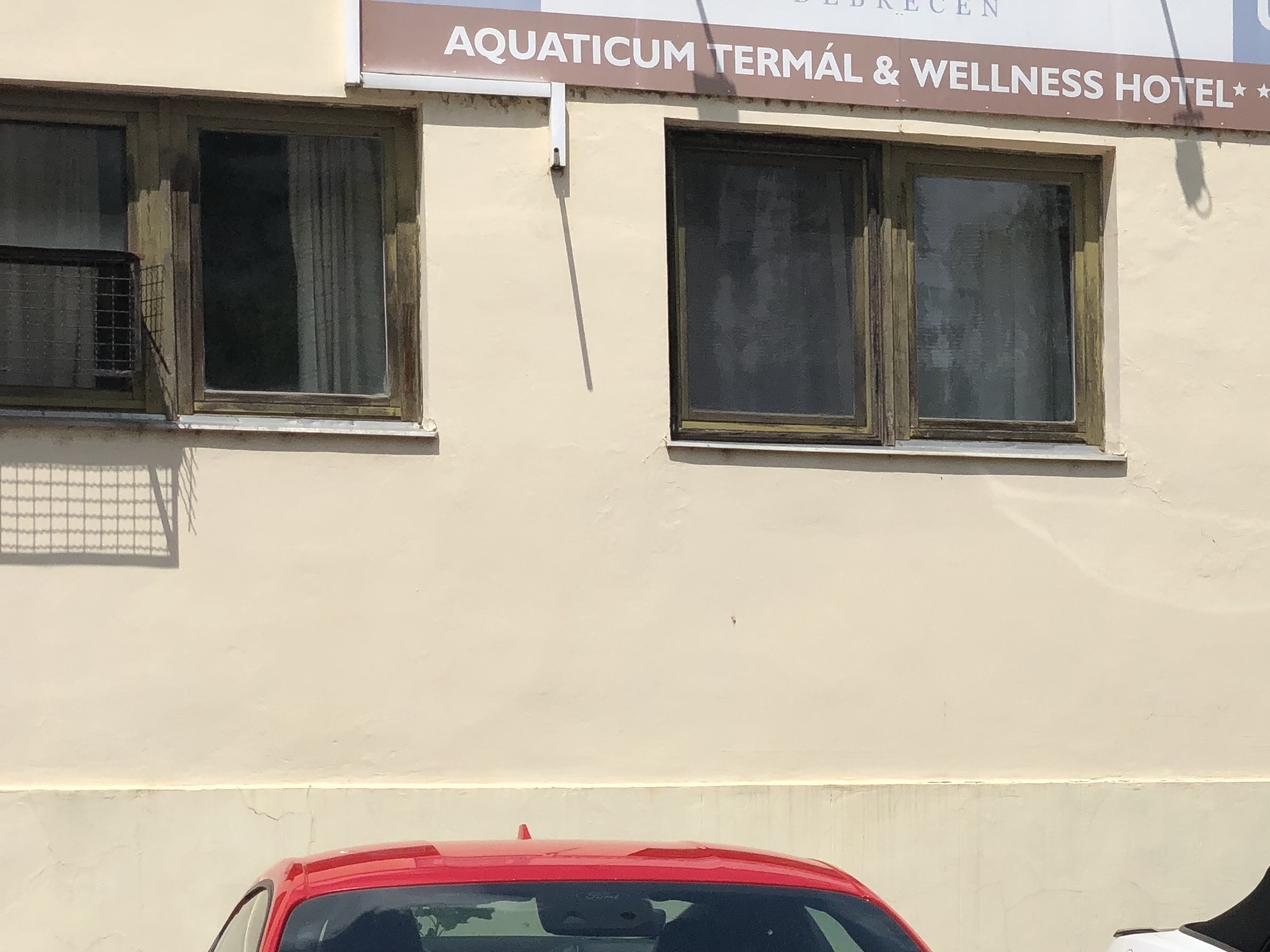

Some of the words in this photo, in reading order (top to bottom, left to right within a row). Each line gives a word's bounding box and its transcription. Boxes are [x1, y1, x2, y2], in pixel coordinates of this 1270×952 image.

[444, 25, 695, 70] AQUATICUM
[707, 42, 863, 83] TERMÁL
[872, 55, 900, 86] &
[909, 57, 1104, 99] WELLNESS
[1115, 72, 1234, 109] HOTEL
